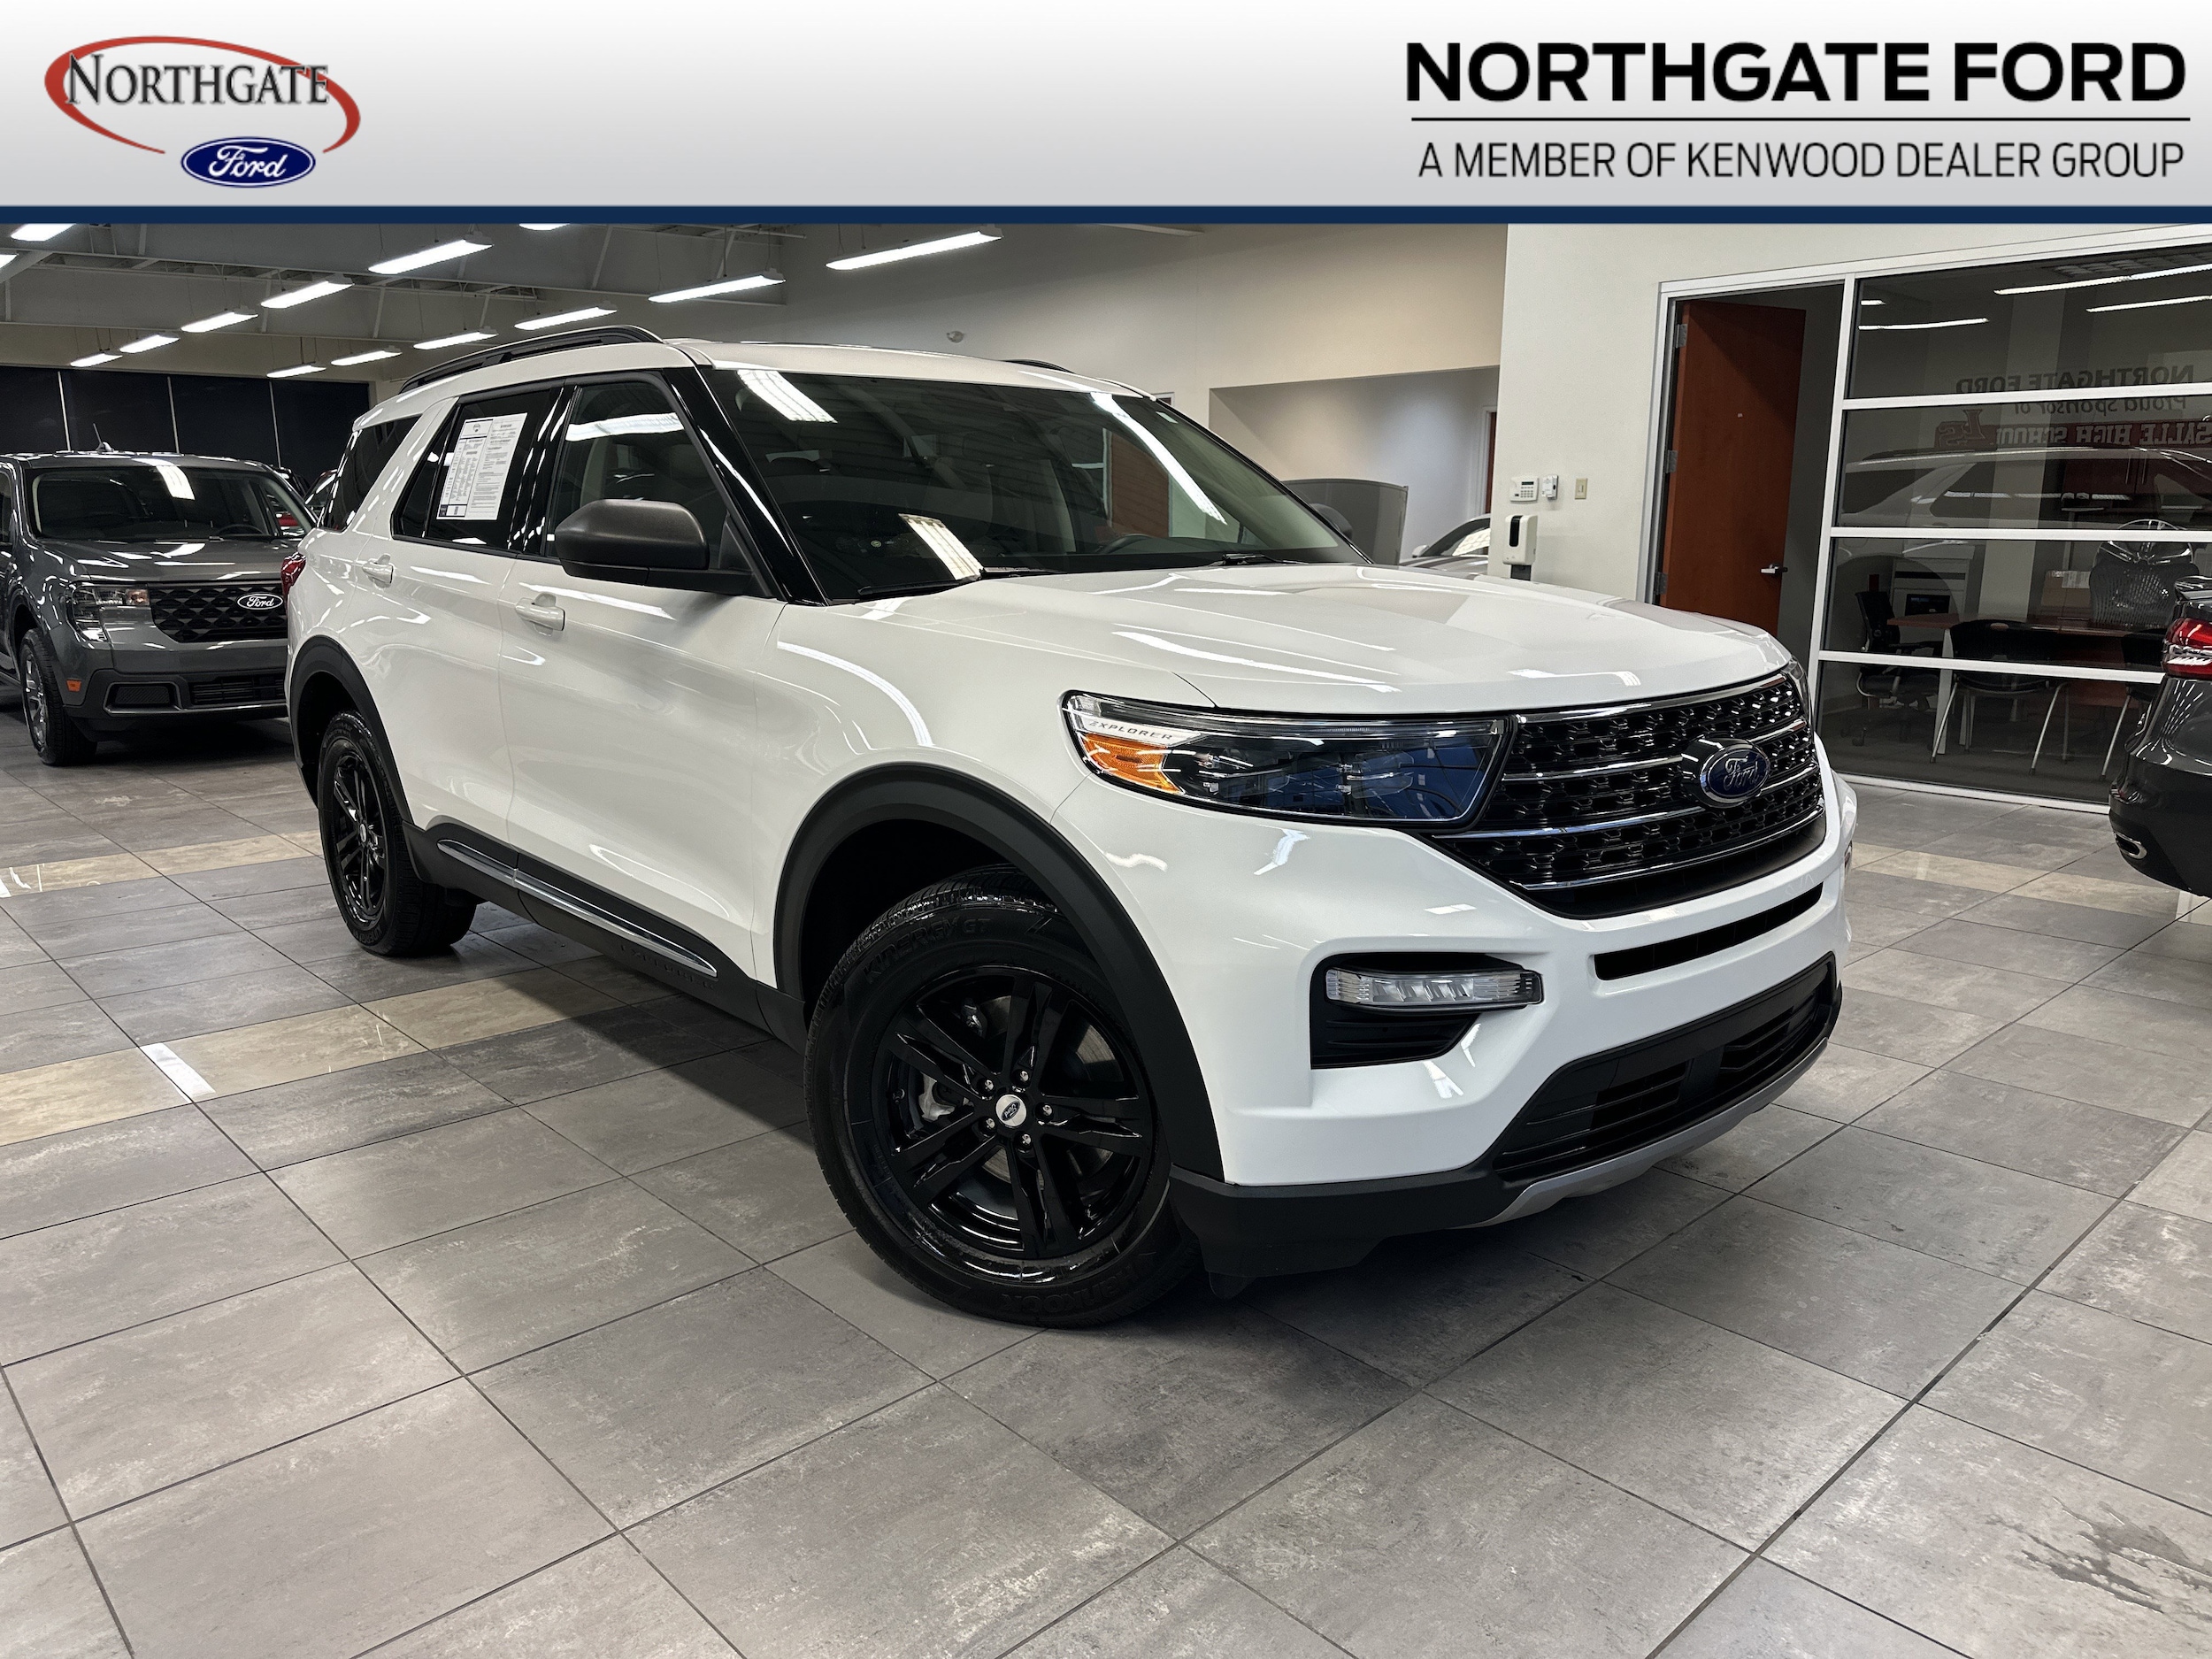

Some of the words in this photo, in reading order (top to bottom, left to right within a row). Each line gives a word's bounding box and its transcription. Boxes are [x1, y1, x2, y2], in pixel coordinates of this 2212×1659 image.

[246, 595, 275, 608] Ford
[1089, 720, 1173, 740] EXPLORER
[1723, 756, 1761, 792] Ford
